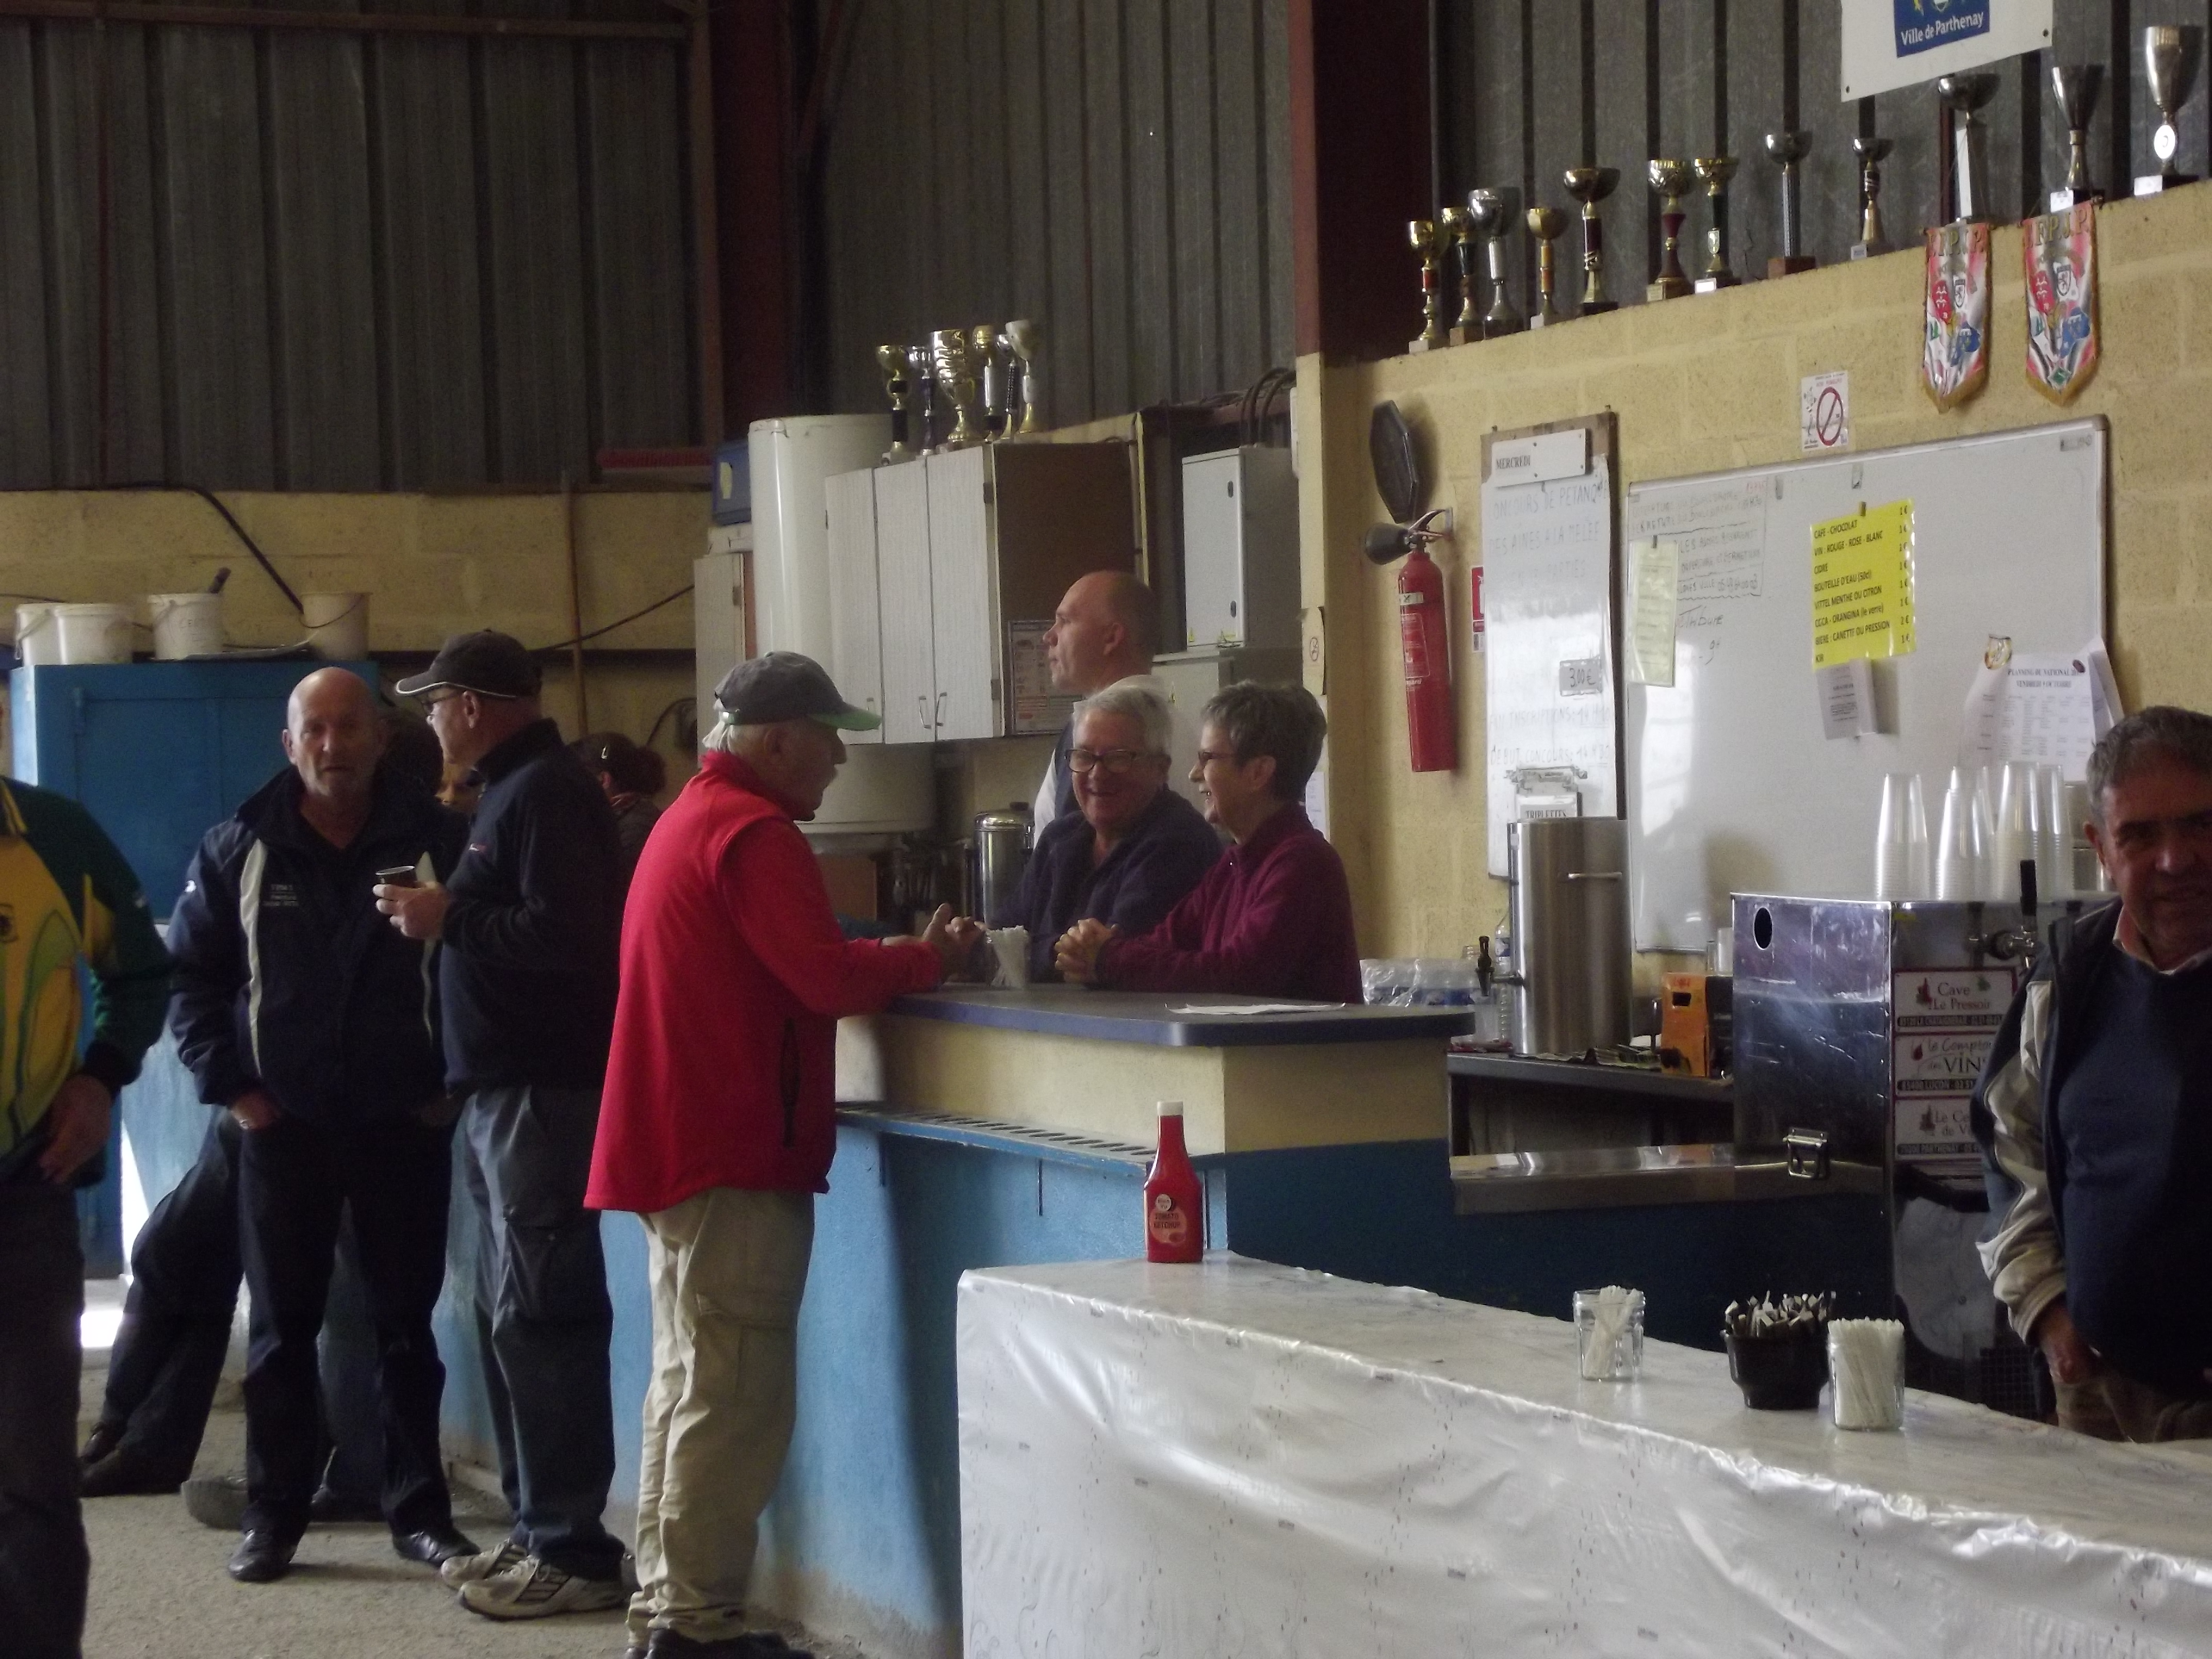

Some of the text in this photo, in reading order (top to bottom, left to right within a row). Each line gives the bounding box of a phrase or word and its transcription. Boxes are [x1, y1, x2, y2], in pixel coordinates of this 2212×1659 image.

[1900, 11, 1985, 46] Ville de Parthenay
[1495, 454, 1531, 470] MERCREDI
[1544, 490, 1555, 510] DE
[1830, 519, 1858, 534] CHOCOLAT
[1827, 541, 1845, 553] ROUGE
[1866, 530, 1883, 543] BLANC
[1814, 563, 1828, 574] CIDRE
[1814, 577, 1840, 592] BOUTEILLE
[1815, 599, 1831, 610] VITTEL
[1831, 592, 1853, 606] MENTHE
[1854, 590, 1862, 600] OU
[1863, 585, 1882, 598] CITRON
[1815, 617, 1829, 627] COCA
[1832, 609, 1860, 623] ORANGINA
[1832, 628, 1855, 641] CANETTE
[1856, 626, 1865, 636] OU
[1865, 620, 1890, 633] PRESSION
[1815, 654, 1824, 663] KIR
[1938, 982, 1971, 996] Cave
[1934, 998, 1991, 1010] Le Pressoir
[1944, 1052, 1986, 1074] VIN
[1935, 1110, 1948, 1123] Le
[1942, 1126, 1955, 1136] de
